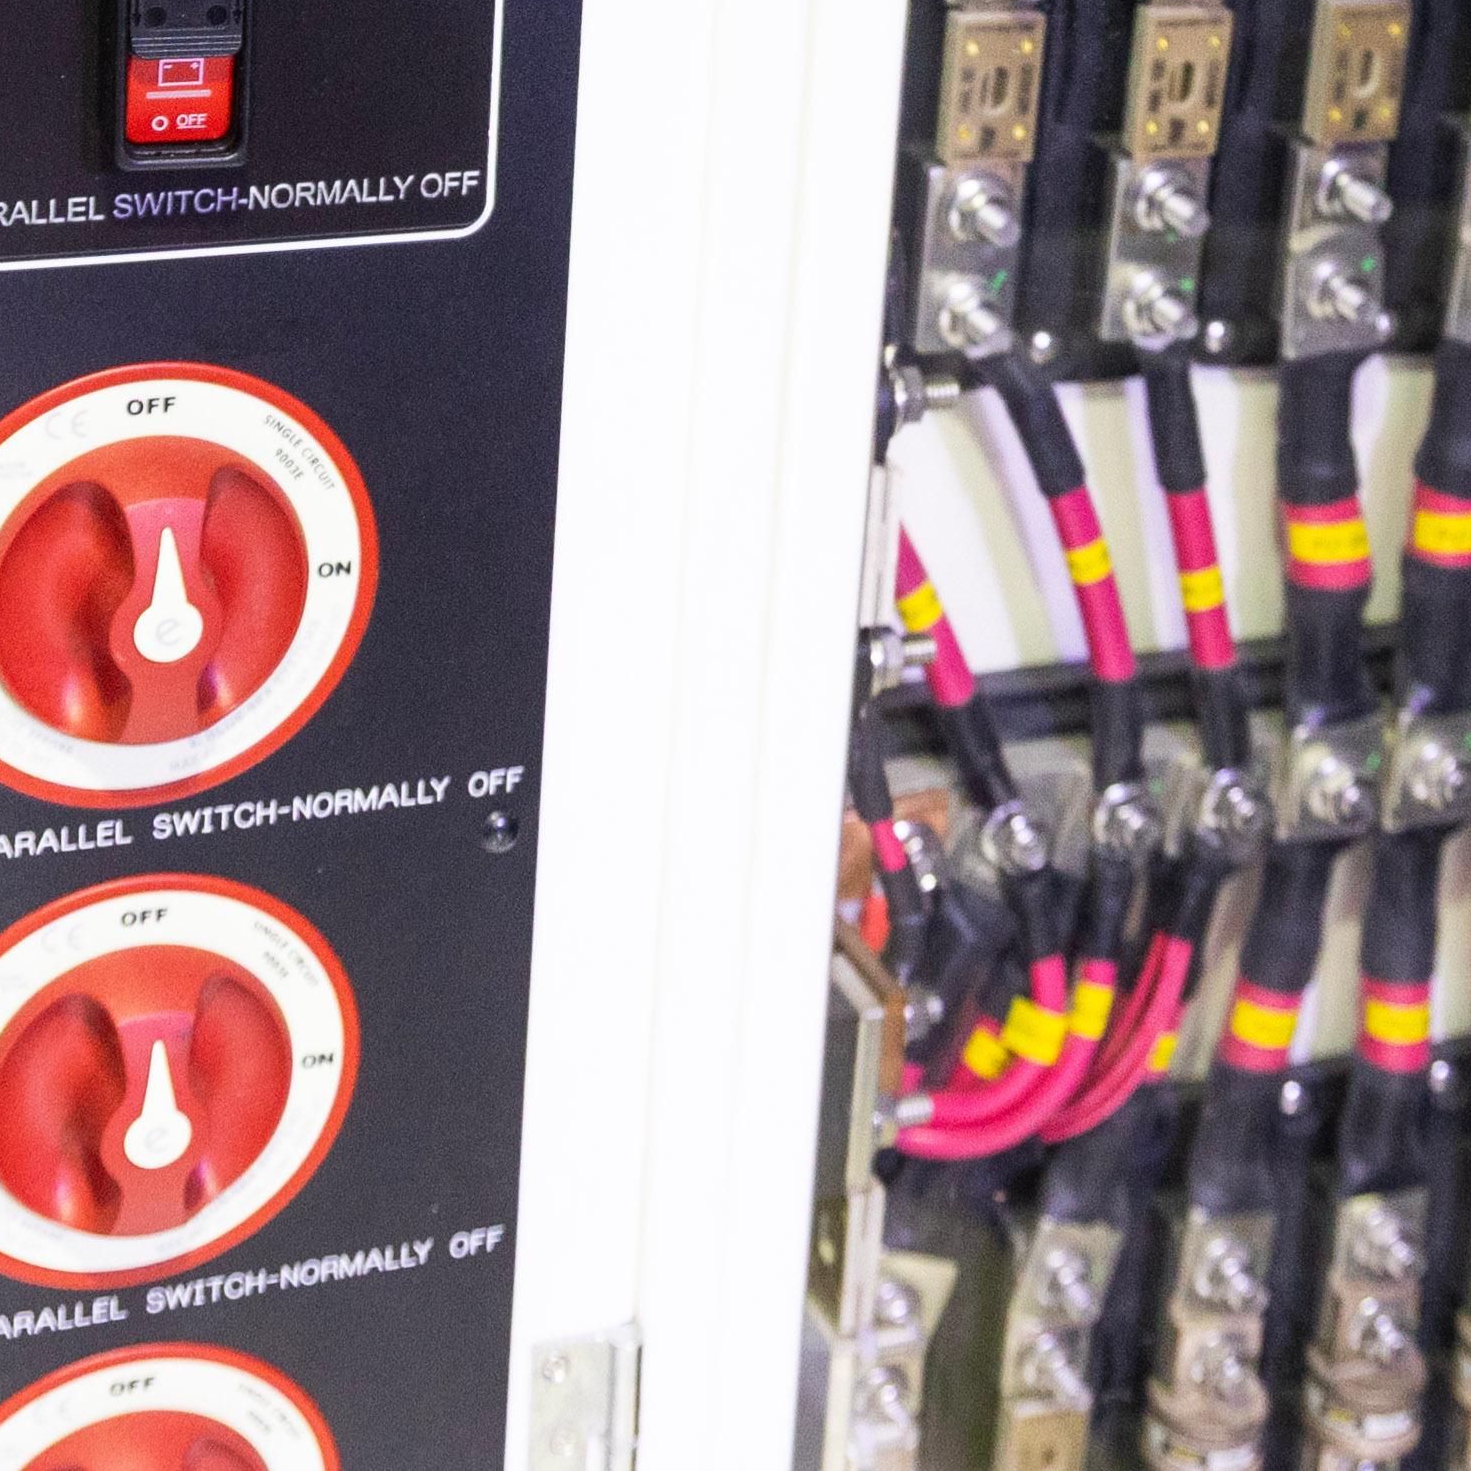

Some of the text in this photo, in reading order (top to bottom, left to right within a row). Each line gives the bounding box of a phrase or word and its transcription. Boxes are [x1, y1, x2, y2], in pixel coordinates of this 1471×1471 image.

[175, 113, 209, 130] OFF
[112, 174, 415, 219] SWITCH-NORMALLY
[420, 170, 481, 198] OFF
[125, 395, 177, 418] OFF
[263, 415, 335, 491] SINGLE CIRCUIT
[316, 560, 353, 580] ON
[151, 776, 450, 841] SWITCH-NORMALLY
[467, 765, 524, 798] OFF
[119, 906, 169, 928] OFF
[301, 1052, 335, 1068] ON
[144, 1237, 435, 1315] SWITCH-NORMALLY
[448, 1224, 504, 1259] OFF
[108, 1375, 155, 1396] OFF
